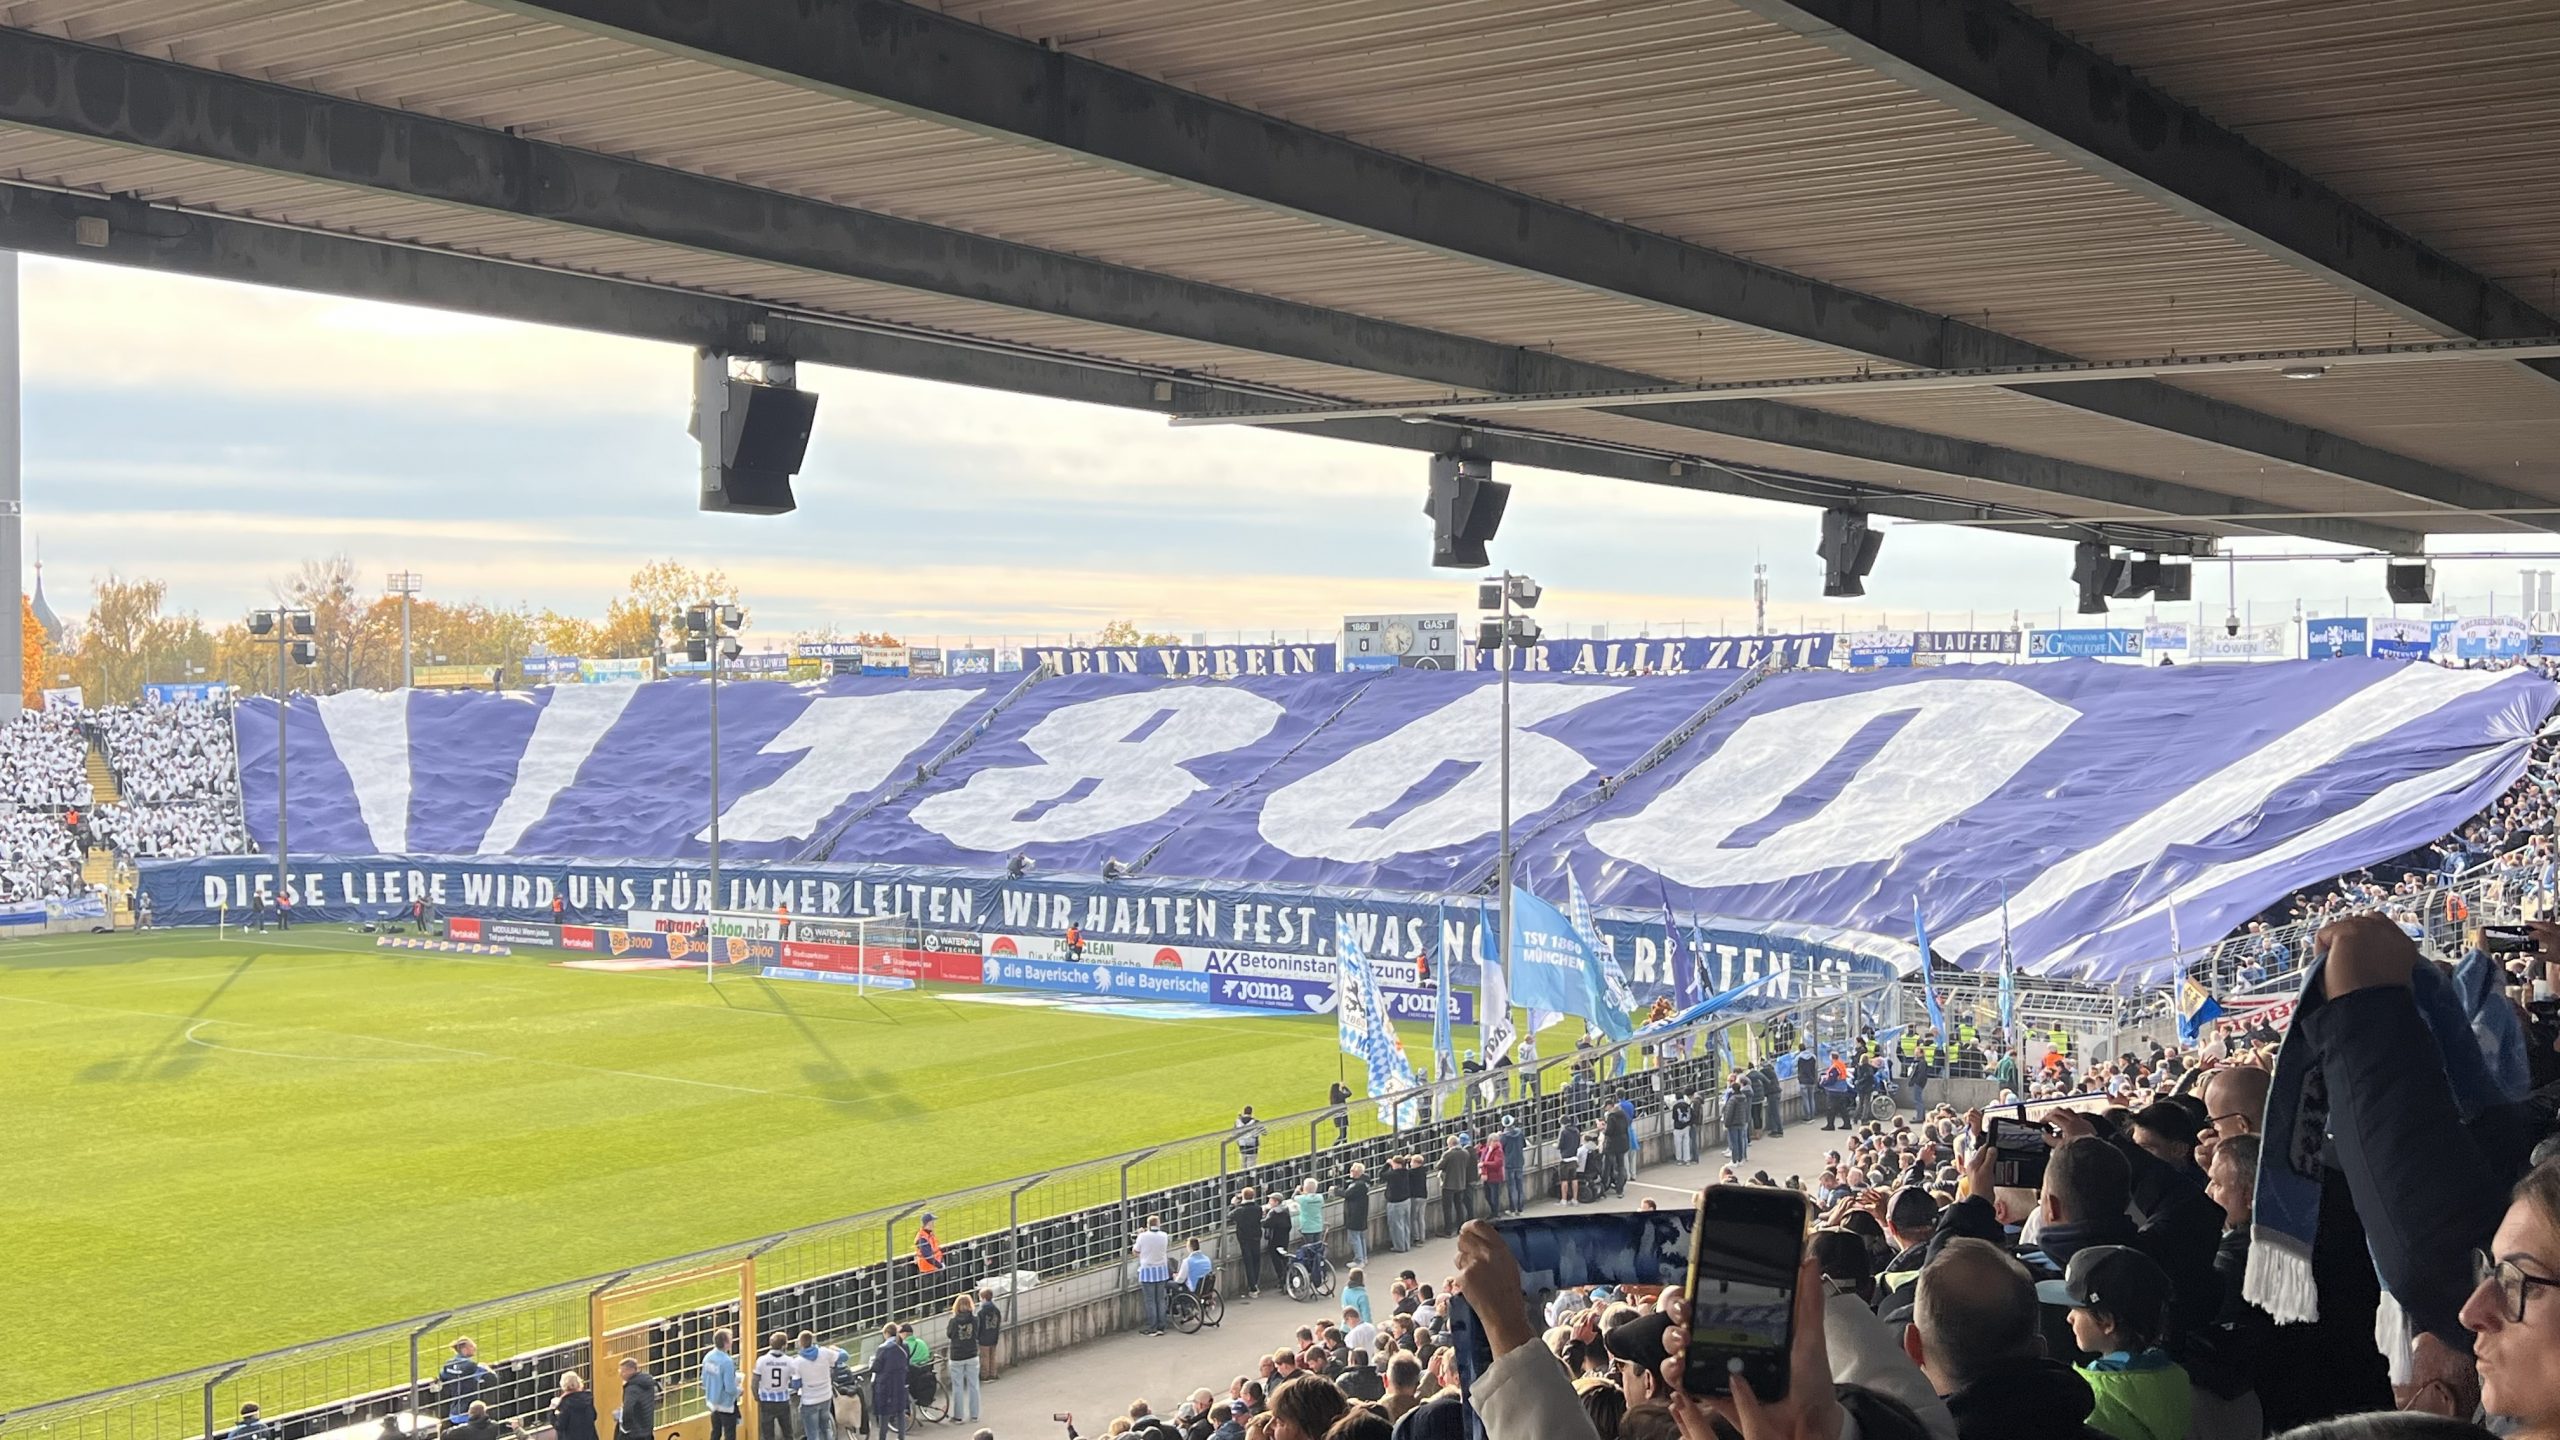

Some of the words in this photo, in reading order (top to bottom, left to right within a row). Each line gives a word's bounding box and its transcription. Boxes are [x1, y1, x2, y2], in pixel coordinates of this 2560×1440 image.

[1352, 623, 1371, 631] 1860
[1424, 620, 1448, 629] GAST
[1935, 634, 2000, 650] LAUFEN
[1036, 650, 1139, 675] MEIN
[1158, 647, 1316, 677] VEREIN
[1572, 641, 1686, 673] ALLE
[1704, 638, 1820, 669] ZEIT
[696, 679, 2083, 888] 1860
[204, 873, 326, 908] DIESE
[342, 870, 446, 905] LIEBE
[462, 873, 551, 909] WIRD
[568, 875, 636, 911] UNS
[651, 871, 711, 912] FÜR
[729, 878, 840, 914] IMMER
[853, 880, 986, 925] LEITEN.
[1002, 890, 1072, 929] WIR
[1086, 896, 1217, 937] HALTEN
[1233, 904, 1328, 956] FEST,
[1346, 912, 1424, 960] WAS
[612, 933, 626, 946] Bet
[629, 938, 653, 949] 3000
[670, 937, 686, 950] Bet
[940, 936, 980, 947] WATERplus
[1054, 939, 1114, 956] POCLEAN
[1523, 931, 1547, 945] TSV
[1552, 935, 1583, 955] 1860
[1523, 949, 1585, 972] MÜNCHEN
[1004, 963, 1022, 978] die
[1025, 965, 1090, 984] Bayerische
[1116, 970, 1135, 987] die
[1138, 974, 1209, 994] Bayerische
[771, 1368, 782, 1388] 9
